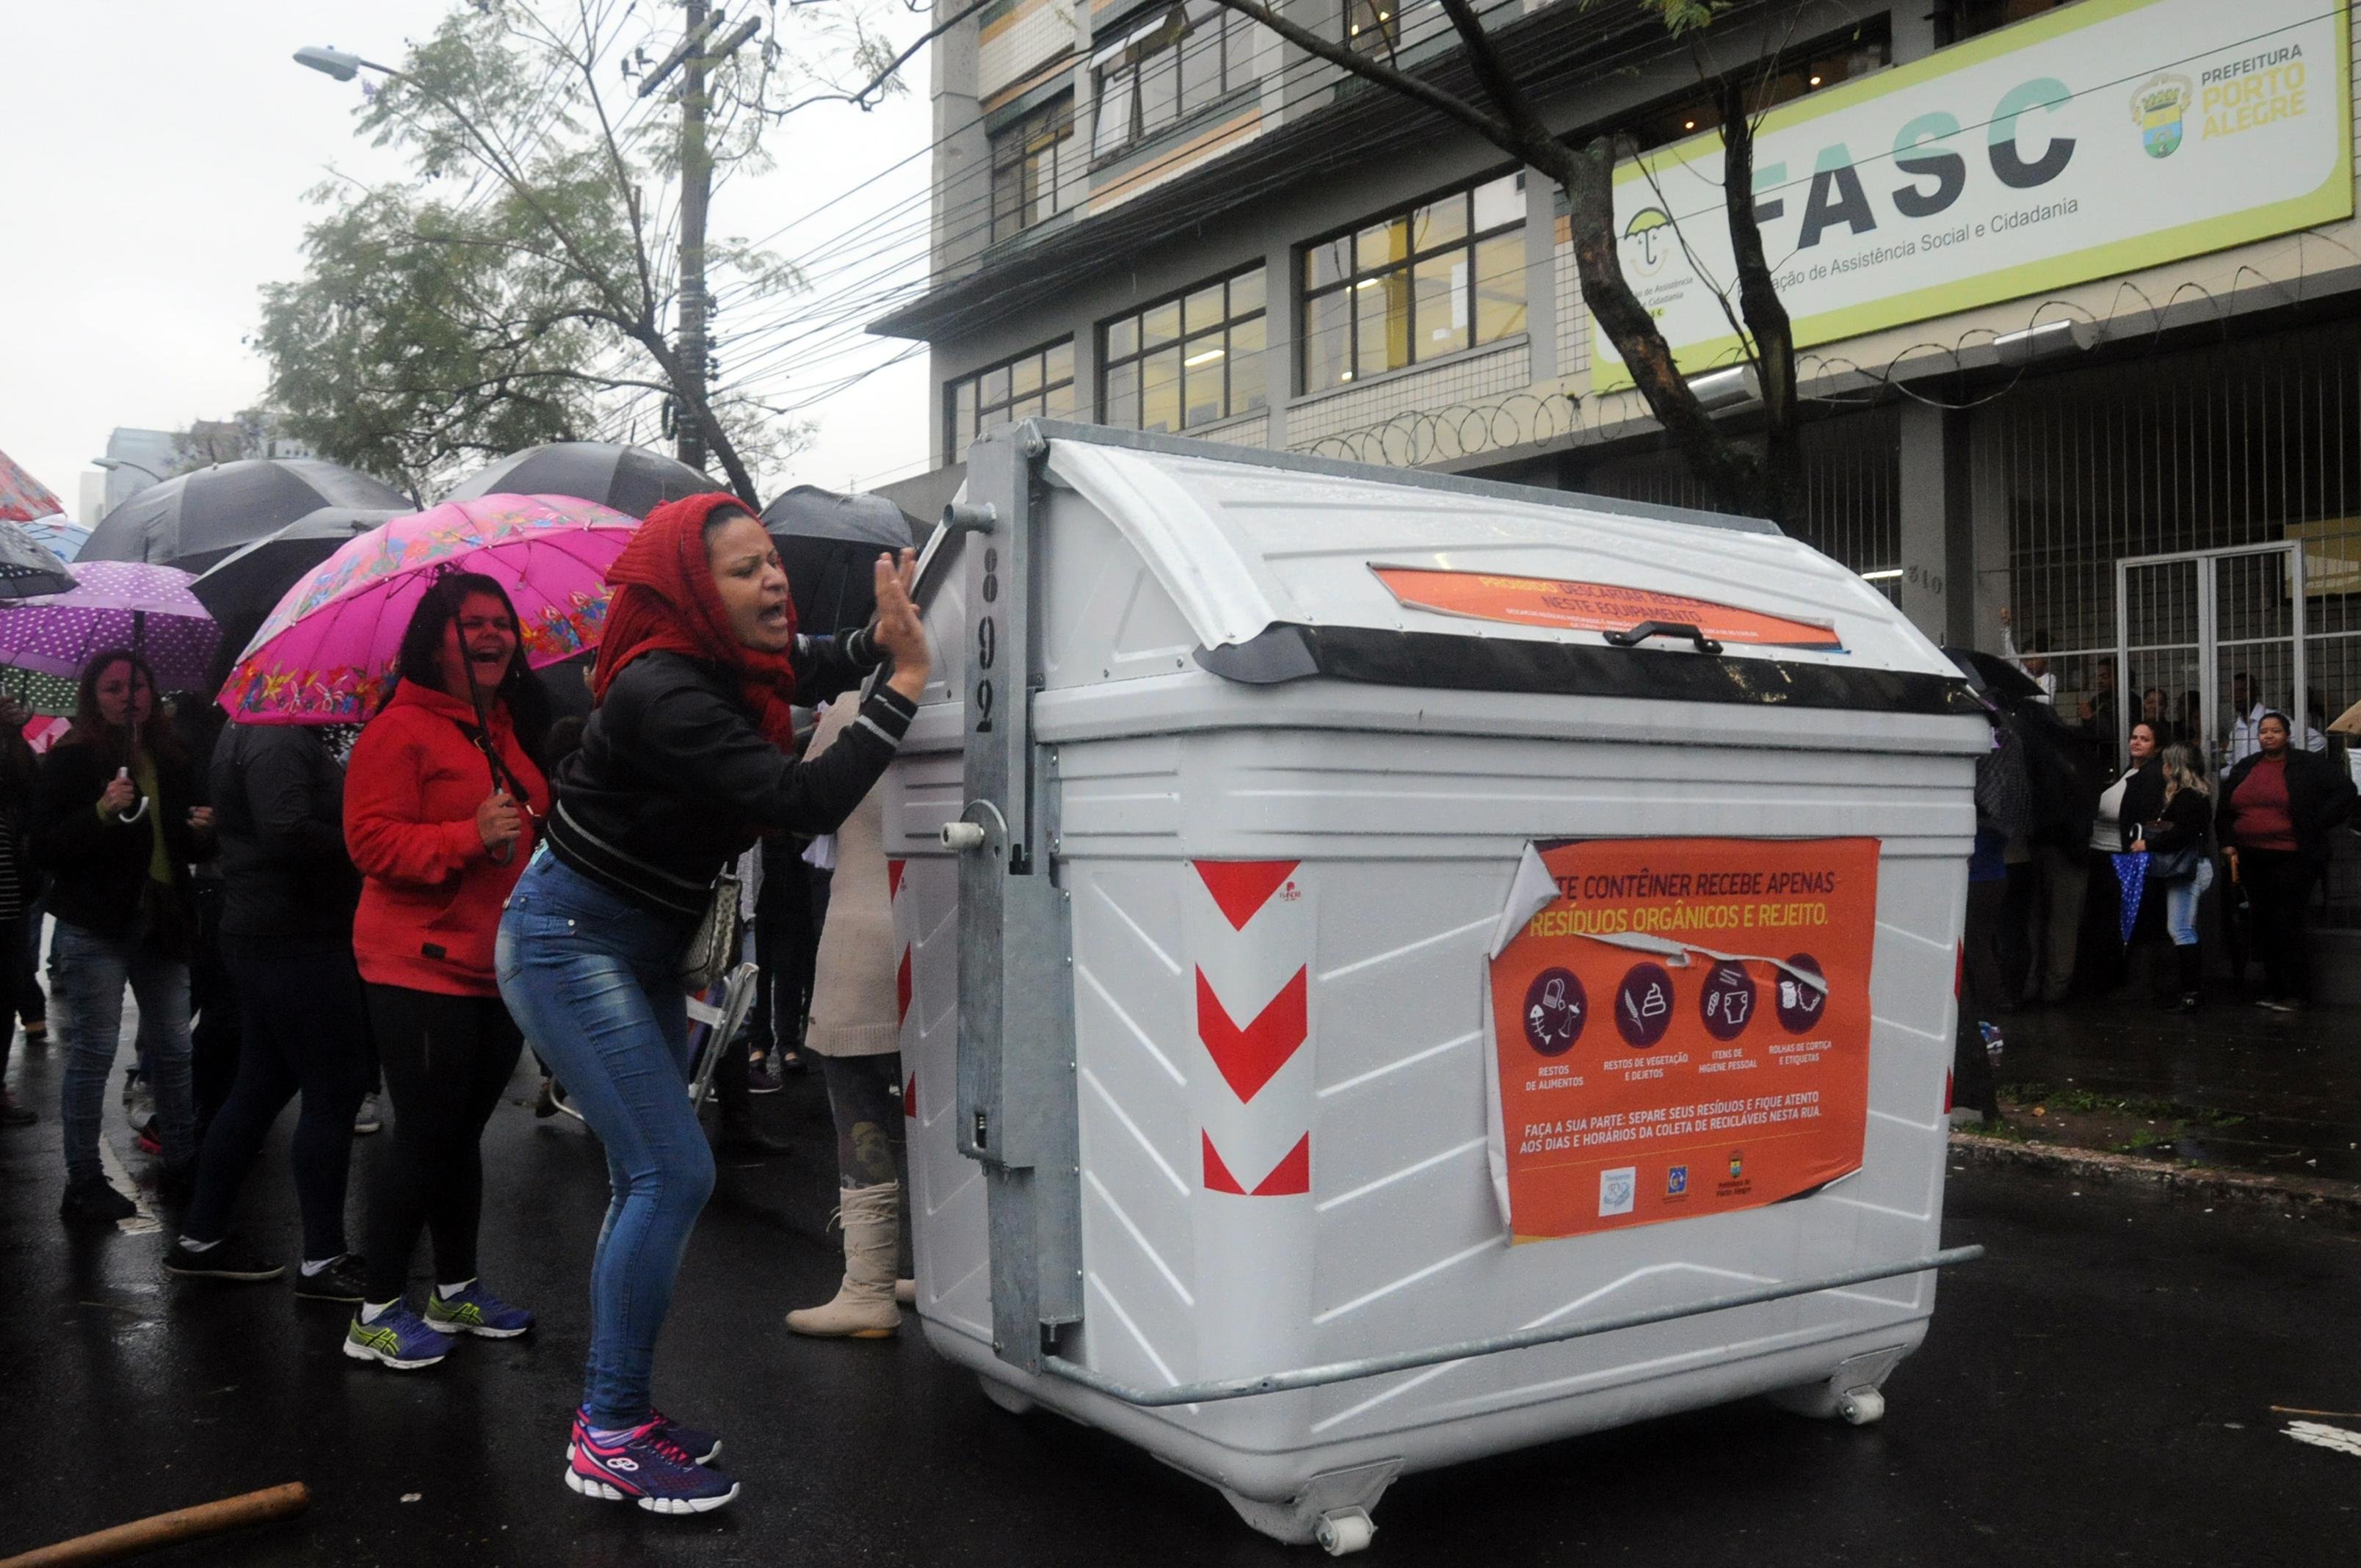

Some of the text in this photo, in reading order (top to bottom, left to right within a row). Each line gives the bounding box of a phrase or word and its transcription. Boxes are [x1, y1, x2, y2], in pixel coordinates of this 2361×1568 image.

[2202, 44, 2302, 86] PREFEITURA
[2203, 61, 2306, 114] PORTO
[2202, 90, 2307, 141] ALEGRE
[1809, 264, 1827, 281] de
[1831, 240, 1915, 275] Assistência
[1921, 225, 1969, 251] Social
[1975, 226, 1985, 238] e
[1991, 197, 2078, 233] Cidadania
[1559, 582, 1645, 603] DESCARTAR
[1542, 595, 1595, 612] NESTE
[1597, 602, 1708, 623] EQUIPAMENTO.
[1584, 868, 1691, 900] CONTÊINER
[1696, 873, 1763, 896] RECEBE
[1766, 871, 1835, 894] APENAS
[1530, 899, 1828, 937] RESÍDUOS ORGÂNICOS E REJEITO.
[1712, 1048, 1743, 1060] ITENS DE
[1769, 1040, 1832, 1054] ROLHAS DE CORTIÇA
[1780, 1053, 1819, 1065] E ETIQUETAS
[1539, 1064, 1570, 1077] RESTOS
[1603, 1051, 1688, 1071] RESTOS DE VEGETAÇÃO
[1699, 1059, 1758, 1074] HIGIENE PESSOAL
[1526, 1077, 1584, 1091] DE ALIMENTOS
[1625, 1069, 1664, 1081] E DEJETOS
[1525, 1091, 1819, 1138] FAÇA A SUA PARTE: SEPARE SEUS RESÍDUOS E FIQUE ATENTO
[1520, 1106, 1821, 1154] AOS DIAS E HORÁRIOS DA COLETA DE RECICLÁVEIS NESTA RUA.
